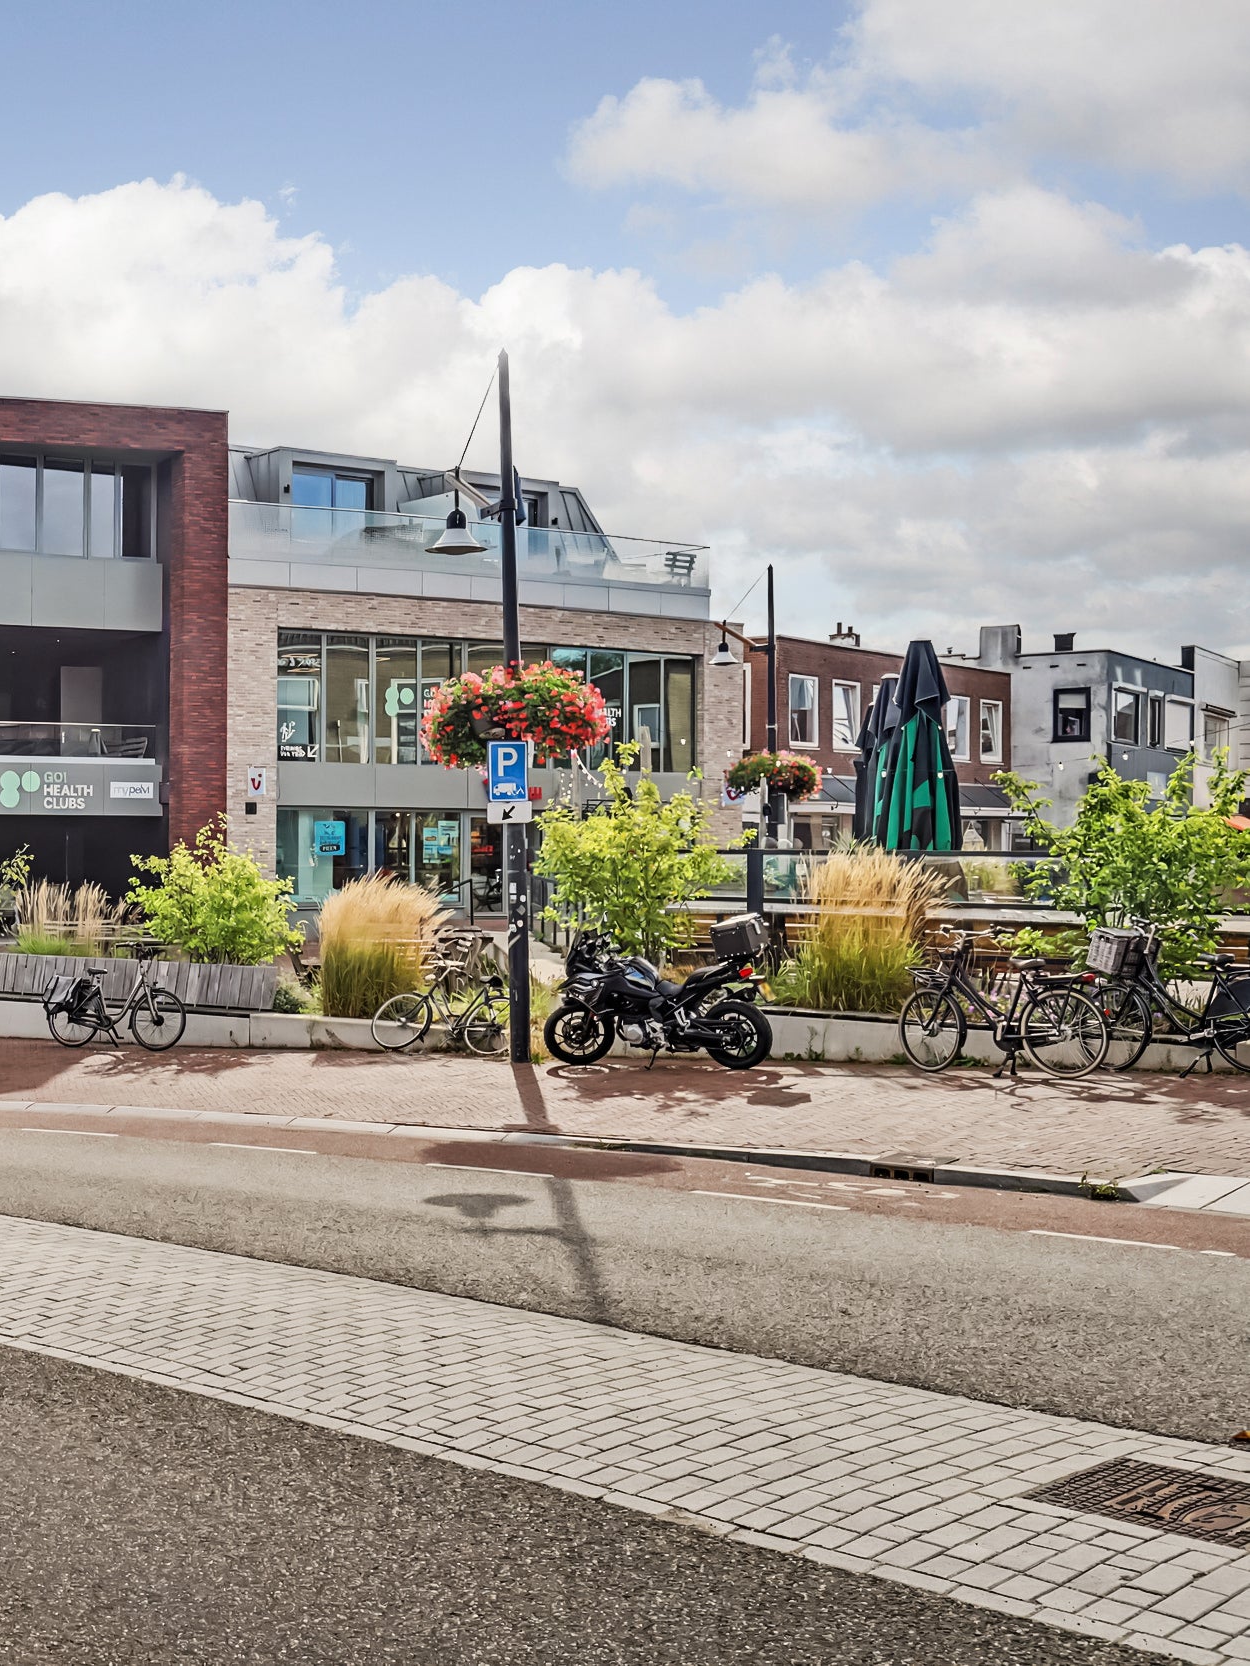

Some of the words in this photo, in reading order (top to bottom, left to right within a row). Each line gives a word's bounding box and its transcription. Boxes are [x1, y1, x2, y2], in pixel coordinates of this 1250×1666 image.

[497, 747, 518, 777] P
[43, 771, 67, 783] GO!
[43, 784, 93, 796] HEALTH
[43, 797, 86, 810] CLUBS
